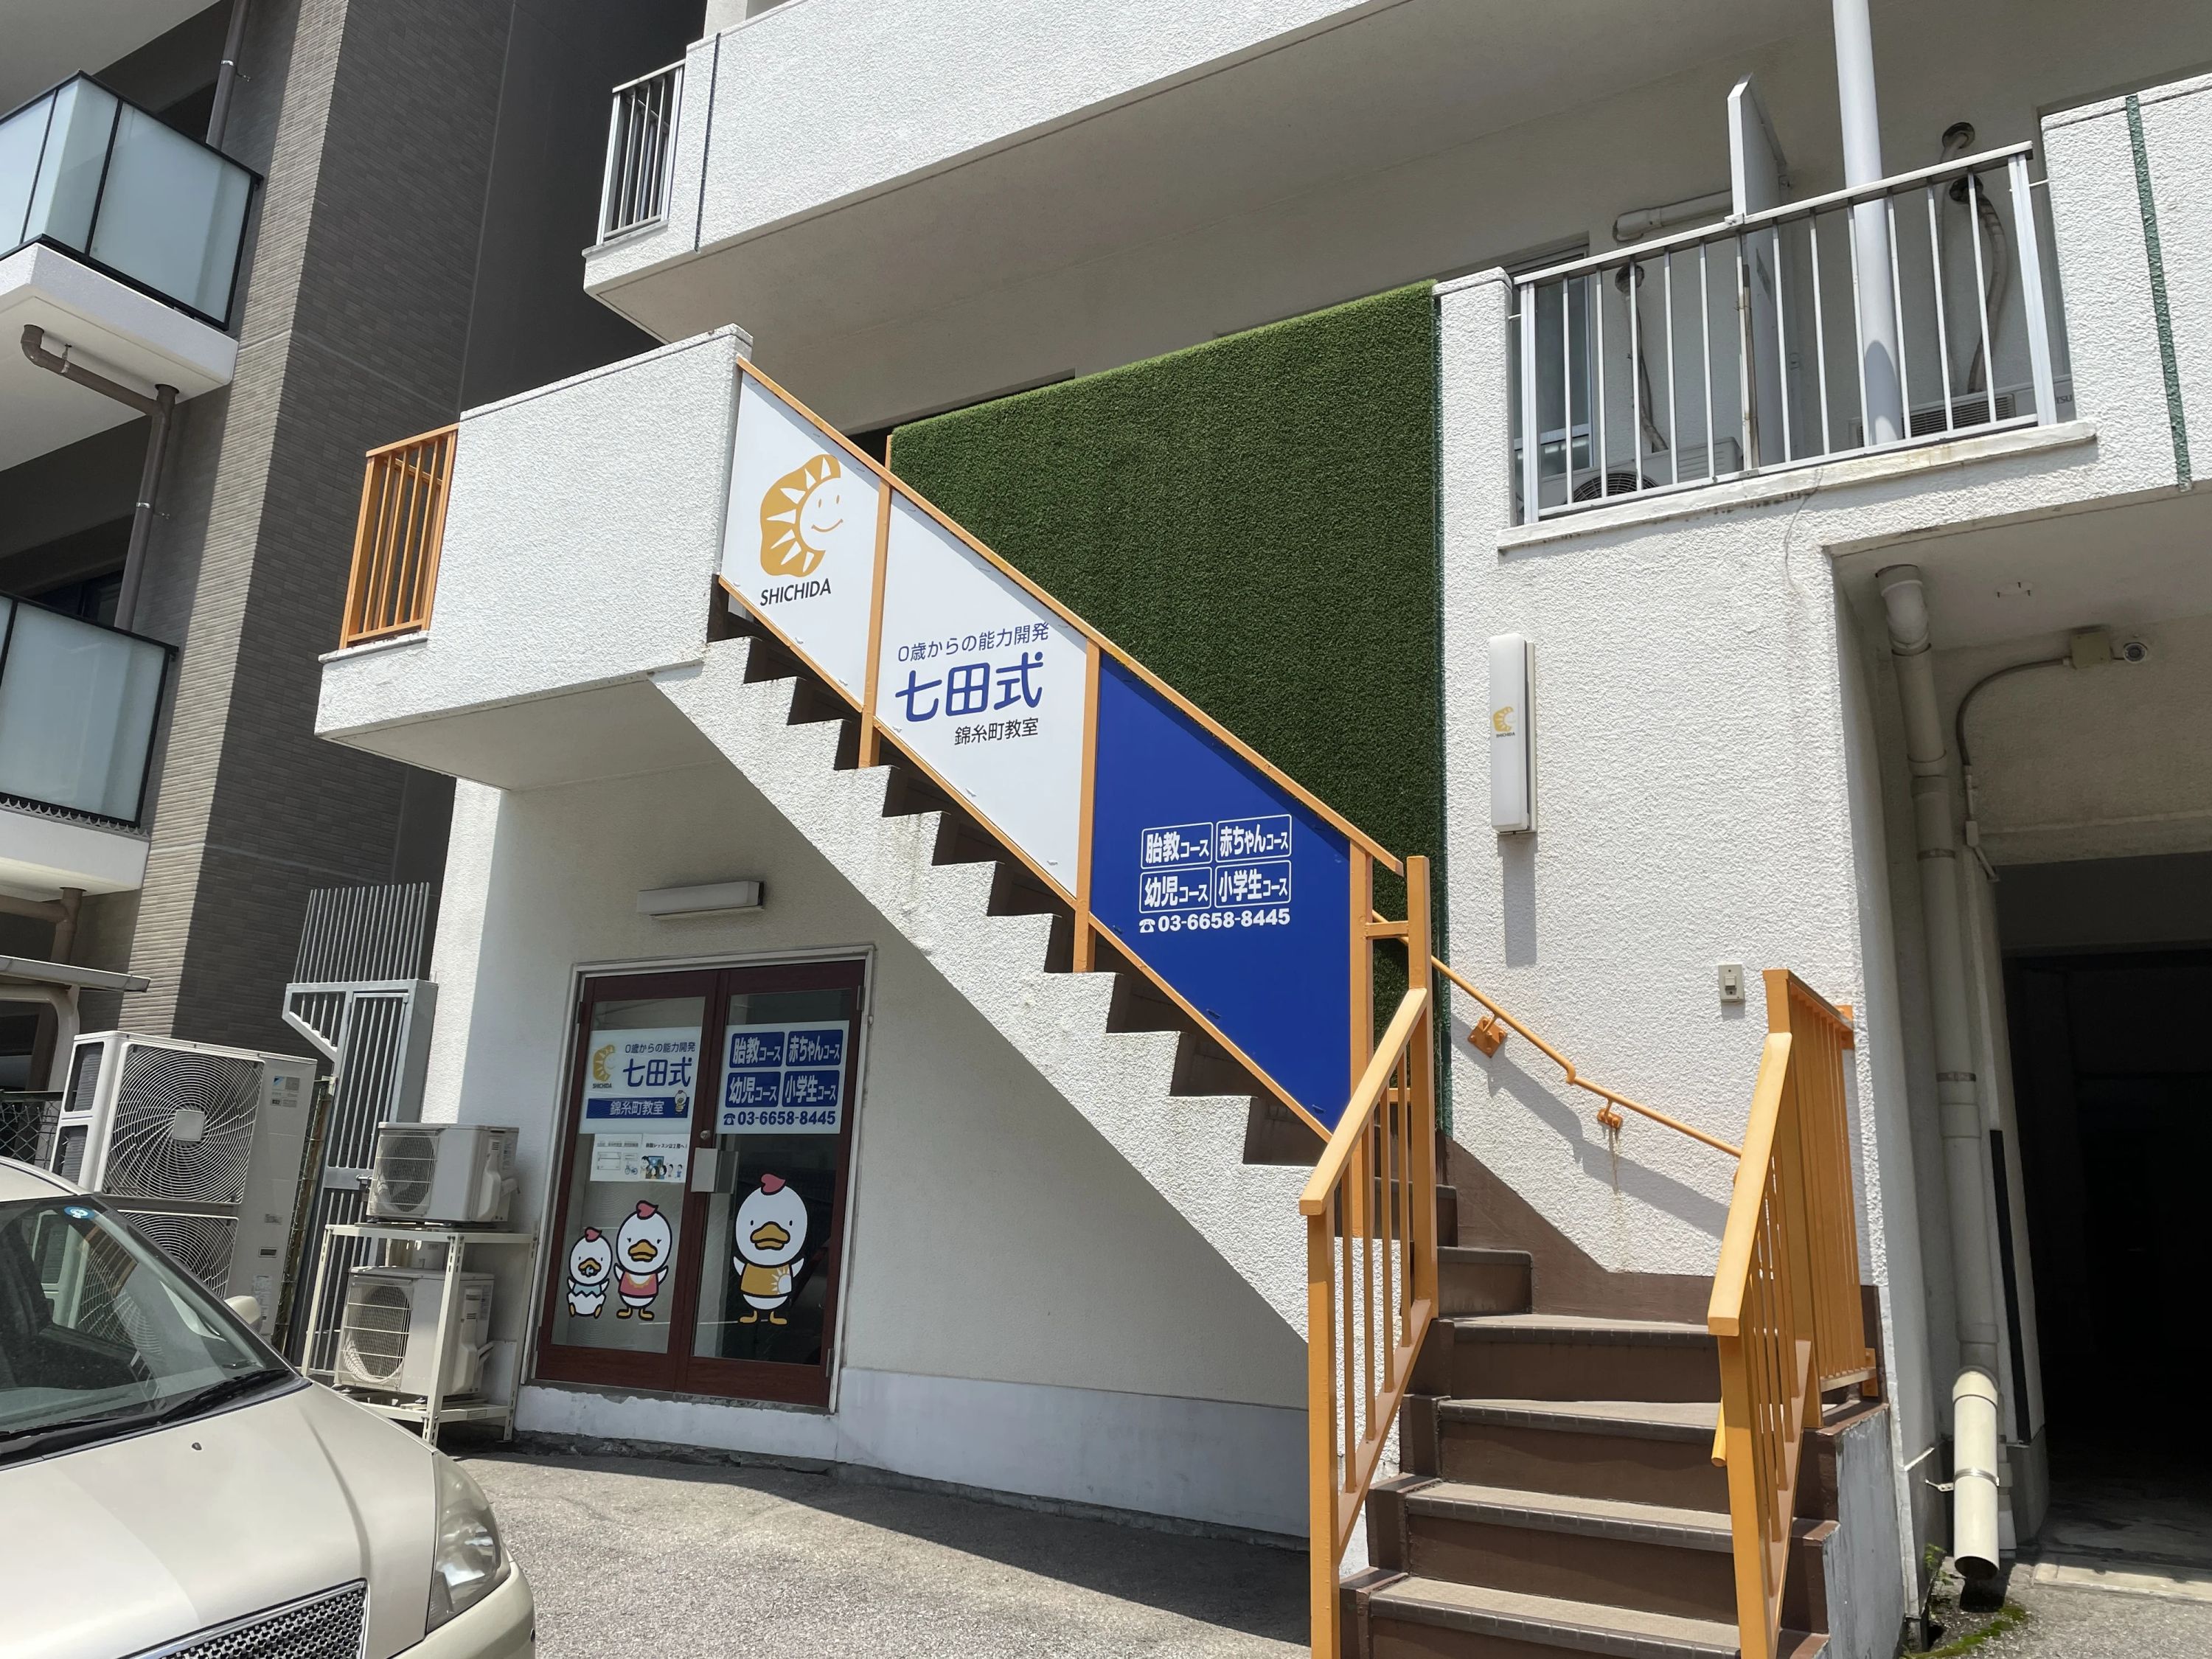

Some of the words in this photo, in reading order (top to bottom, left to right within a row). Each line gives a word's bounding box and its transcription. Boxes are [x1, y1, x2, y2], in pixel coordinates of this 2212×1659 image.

[759, 577, 832, 606] SHICHIDA
[897, 622, 1049, 661] 0歳からの能力開発
[894, 651, 1044, 723] 七田式
[954, 717, 1039, 745] 錦糸町教室
[1145, 831, 1210, 864] 胎教コース
[1220, 824, 1289, 857] 赤ちゃんコース
[1144, 875, 1208, 908] 幼児コース
[1218, 869, 1288, 902] 小学生コース
[1158, 908, 1290, 932] 03-6658-8445
[625, 1042, 696, 1054] 0歳からの能力開発
[732, 1037, 782, 1065] 胎教コース
[788, 1035, 840, 1062] 赤ちゃんコース
[622, 1056, 692, 1088] 七田式
[728, 1077, 777, 1104] 幼児コース
[785, 1074, 836, 1104] 小学生コース
[609, 1101, 664, 1116] 錦糸町教室
[737, 1110, 836, 1126] 03-6658-8445
